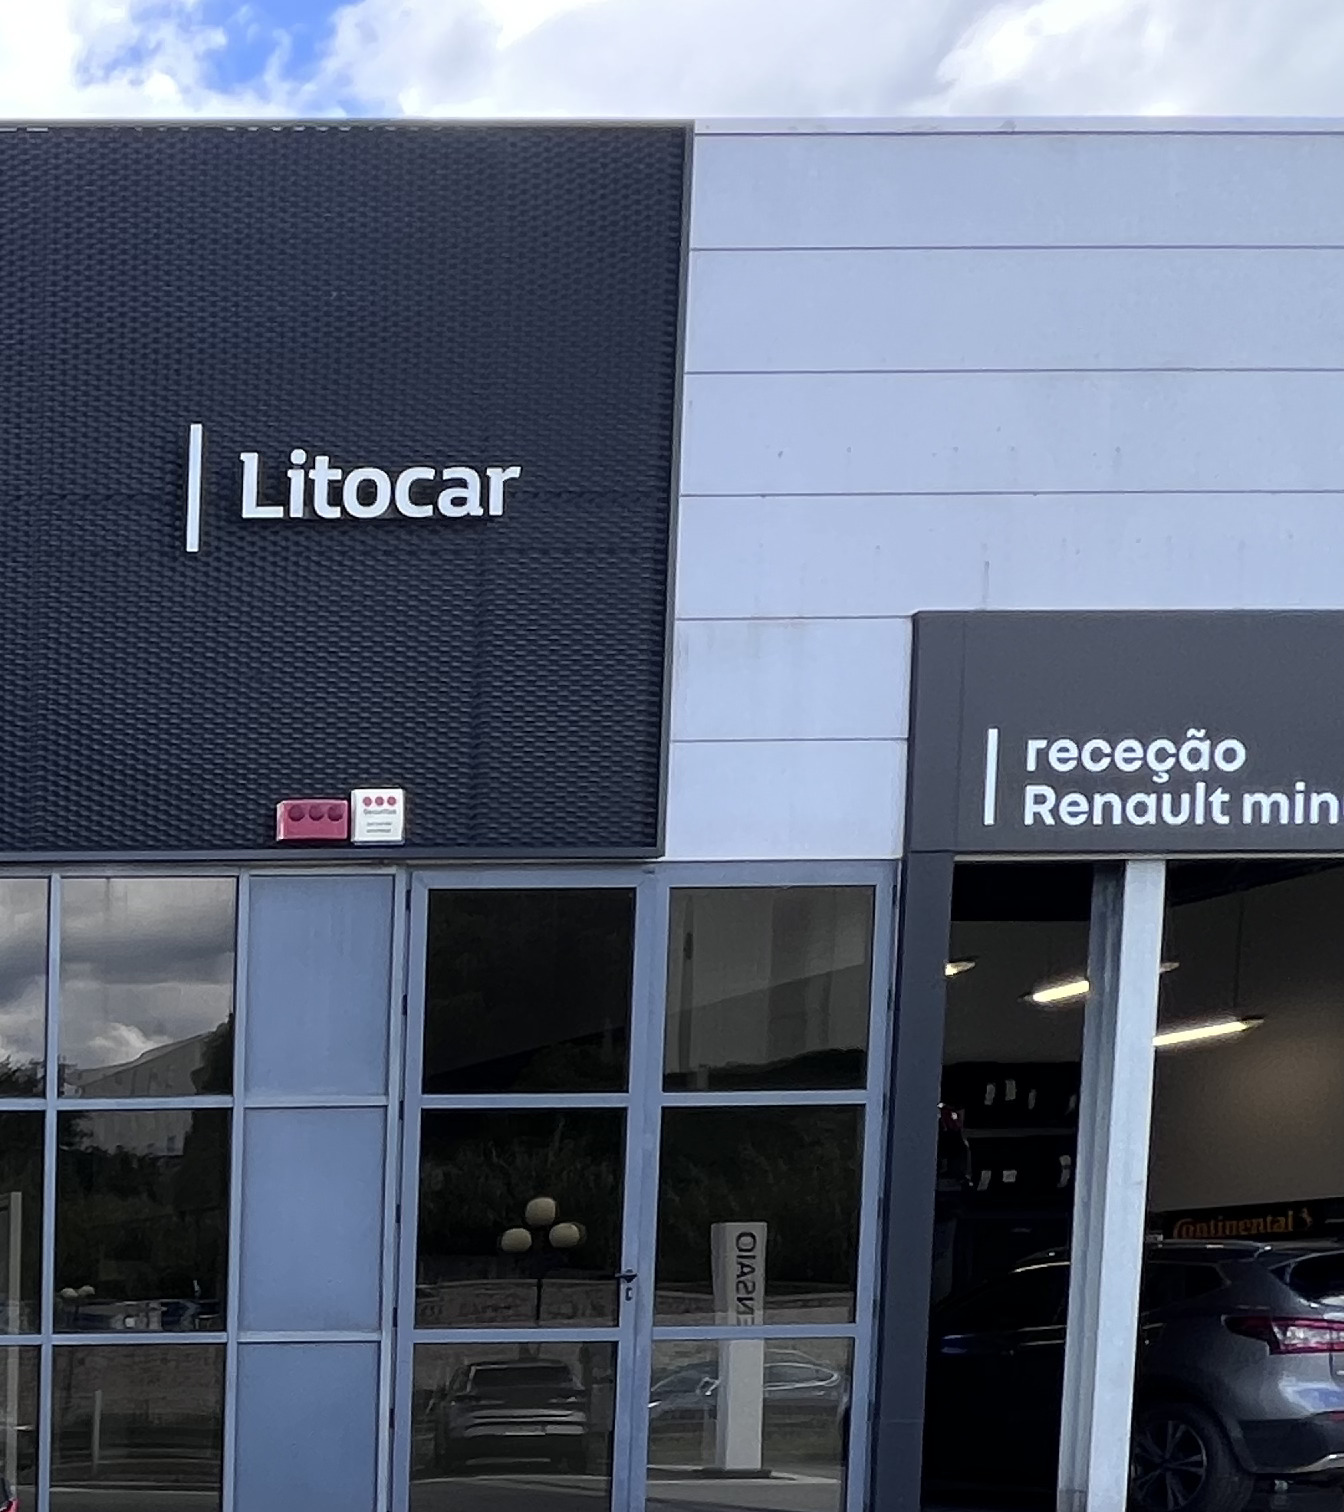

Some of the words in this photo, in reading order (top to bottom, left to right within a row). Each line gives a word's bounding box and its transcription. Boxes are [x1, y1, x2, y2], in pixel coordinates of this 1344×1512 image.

[240, 449, 521, 518] Litocar
[1026, 728, 1246, 783] receção
[1024, 782, 1229, 826] Renault
[1242, 782, 1344, 825] min
